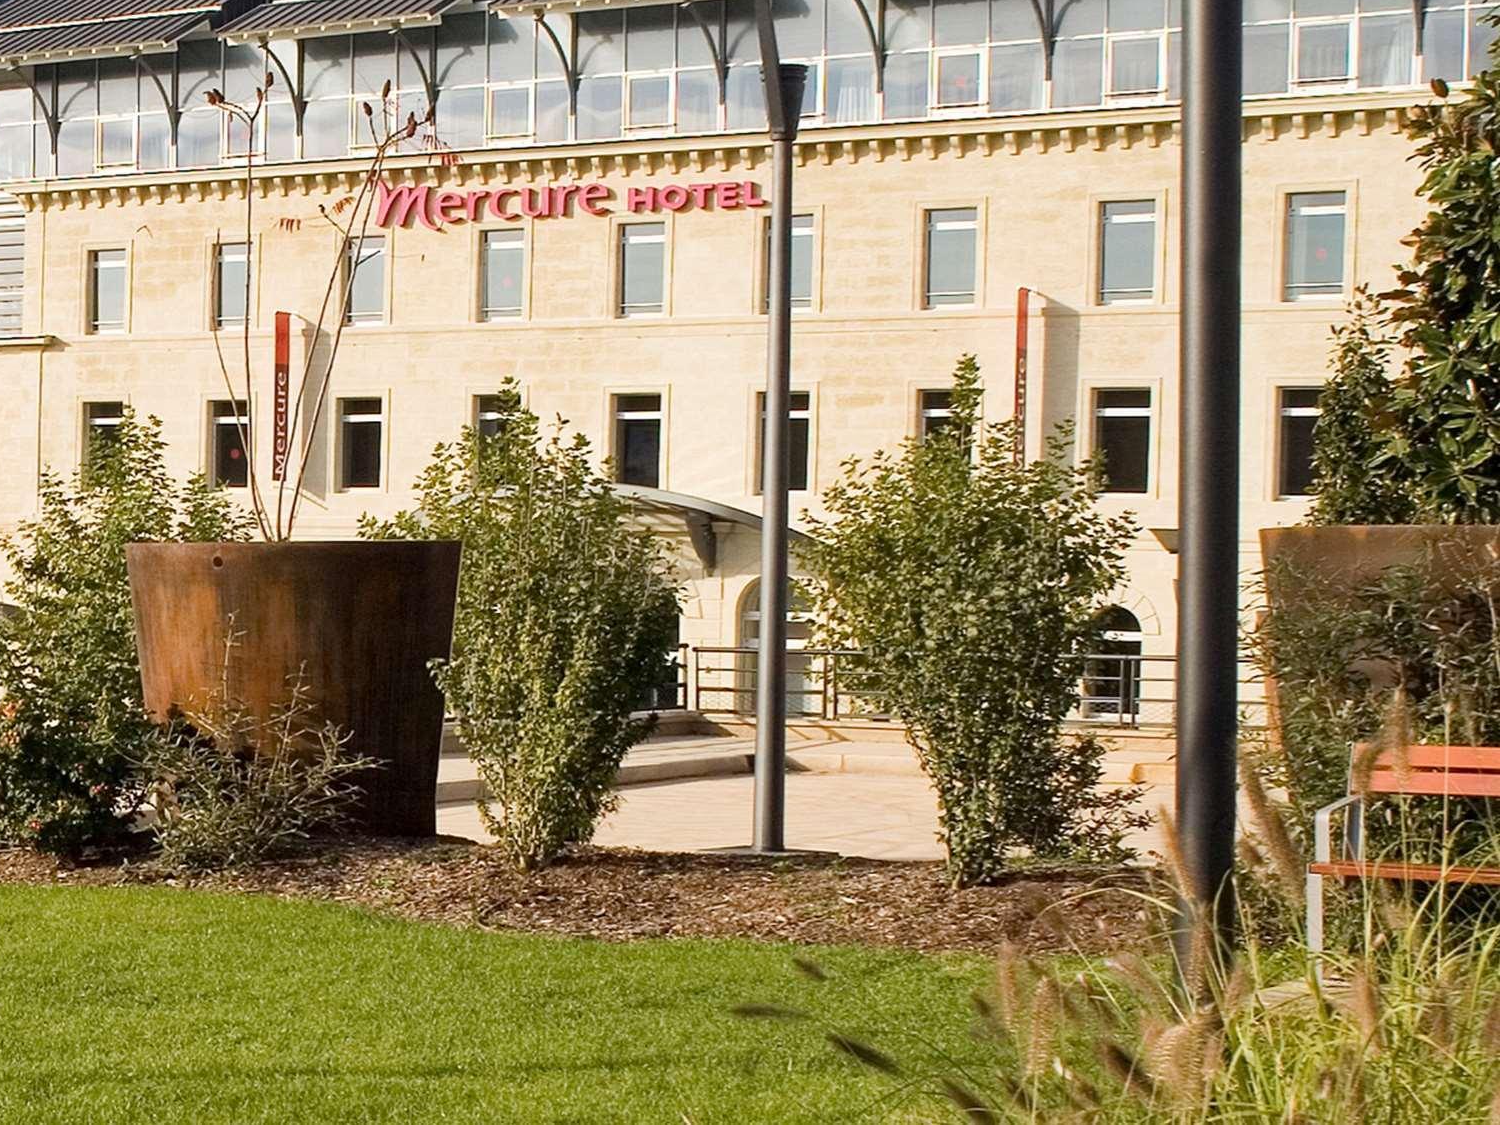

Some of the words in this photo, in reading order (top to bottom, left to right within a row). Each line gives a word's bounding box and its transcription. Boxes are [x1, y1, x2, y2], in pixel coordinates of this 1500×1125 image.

[375, 180, 611, 231] Mercure
[628, 181, 764, 212] HOTEL
[275, 370, 287, 477] Mercure
